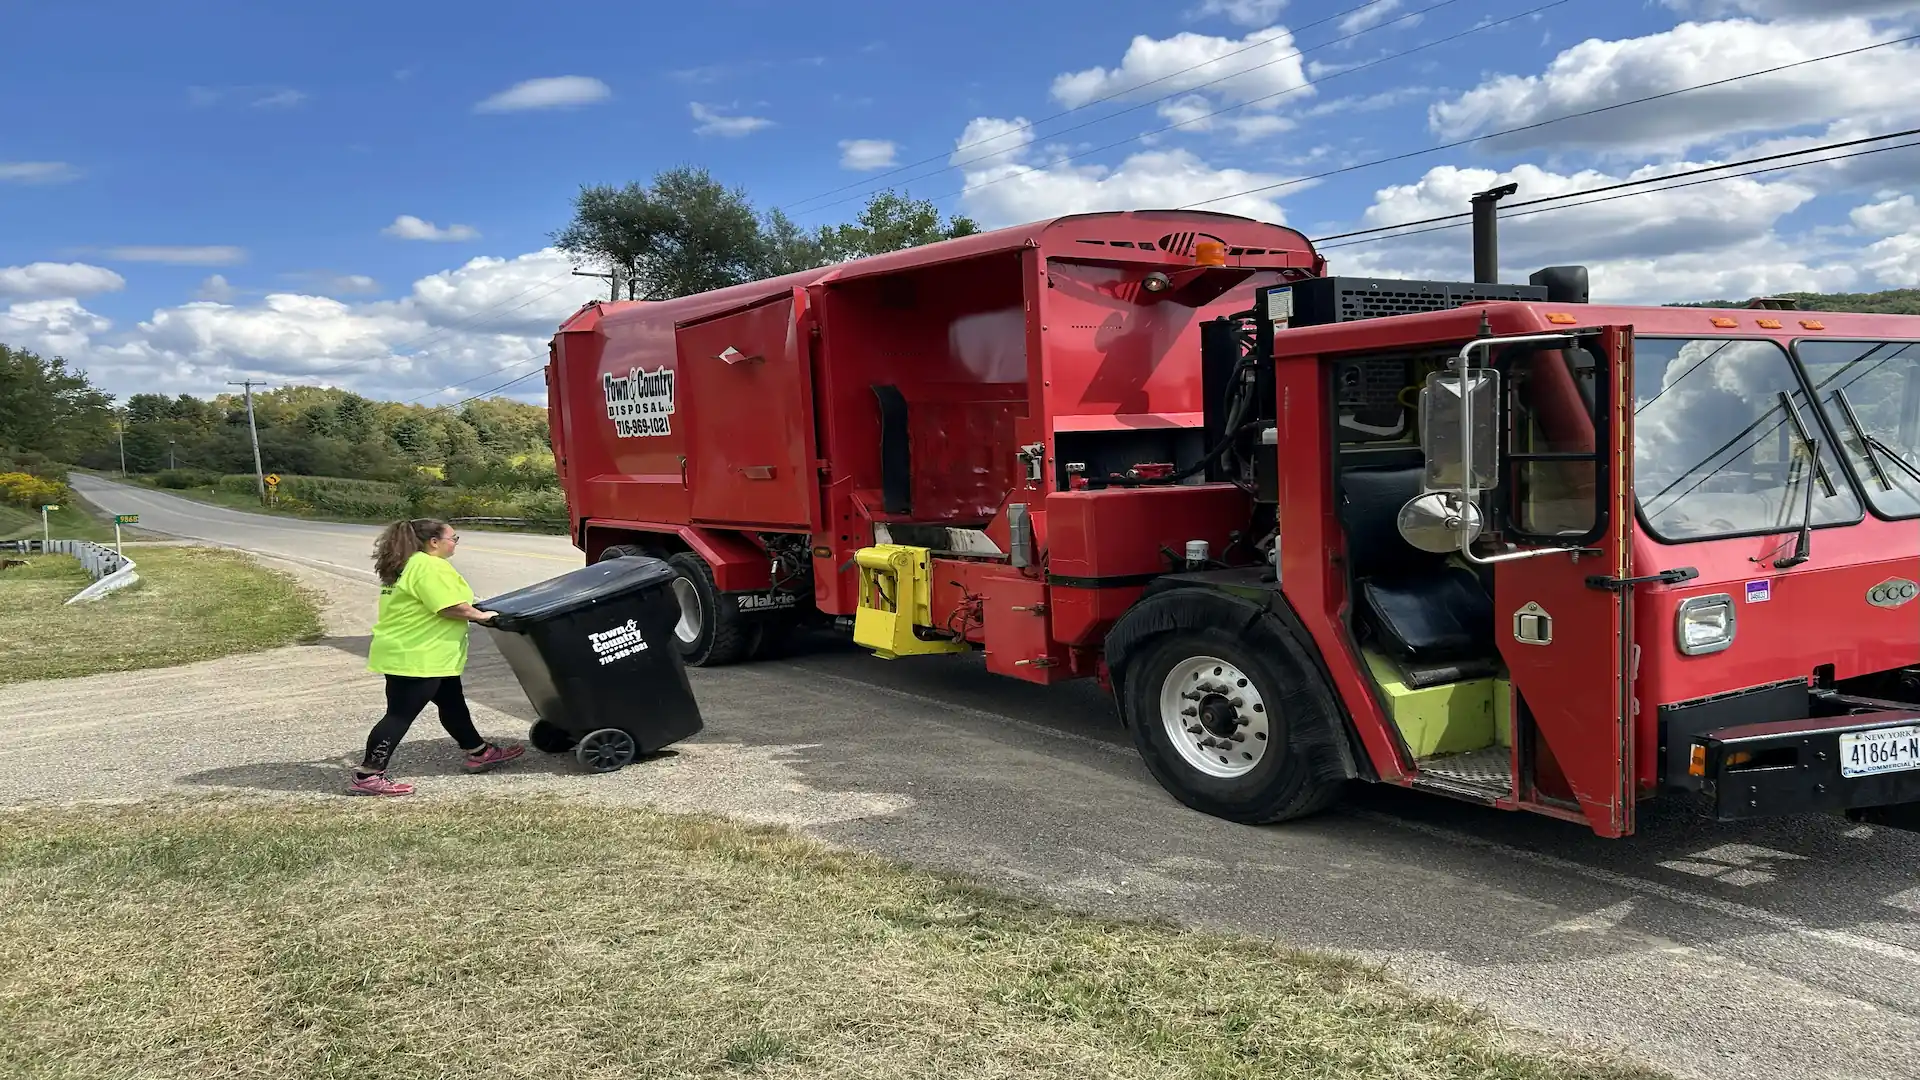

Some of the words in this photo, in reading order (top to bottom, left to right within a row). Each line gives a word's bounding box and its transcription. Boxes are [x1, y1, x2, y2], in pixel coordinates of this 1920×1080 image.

[605, 375, 629, 402] Town
[629, 370, 637, 402] &
[638, 369, 673, 402] Country
[609, 402, 664, 416] DISPOSAL
[617, 417, 669, 435] 716-969-1021
[1873, 584, 1914, 603] CCC
[588, 626, 626, 644] Town
[625, 619, 638, 632] &
[592, 629, 641, 653] Country
[1864, 733, 1886, 741] NEW
[1888, 730, 1912, 739] YORK
[1867, 762, 1912, 771] COMMERCIAL
